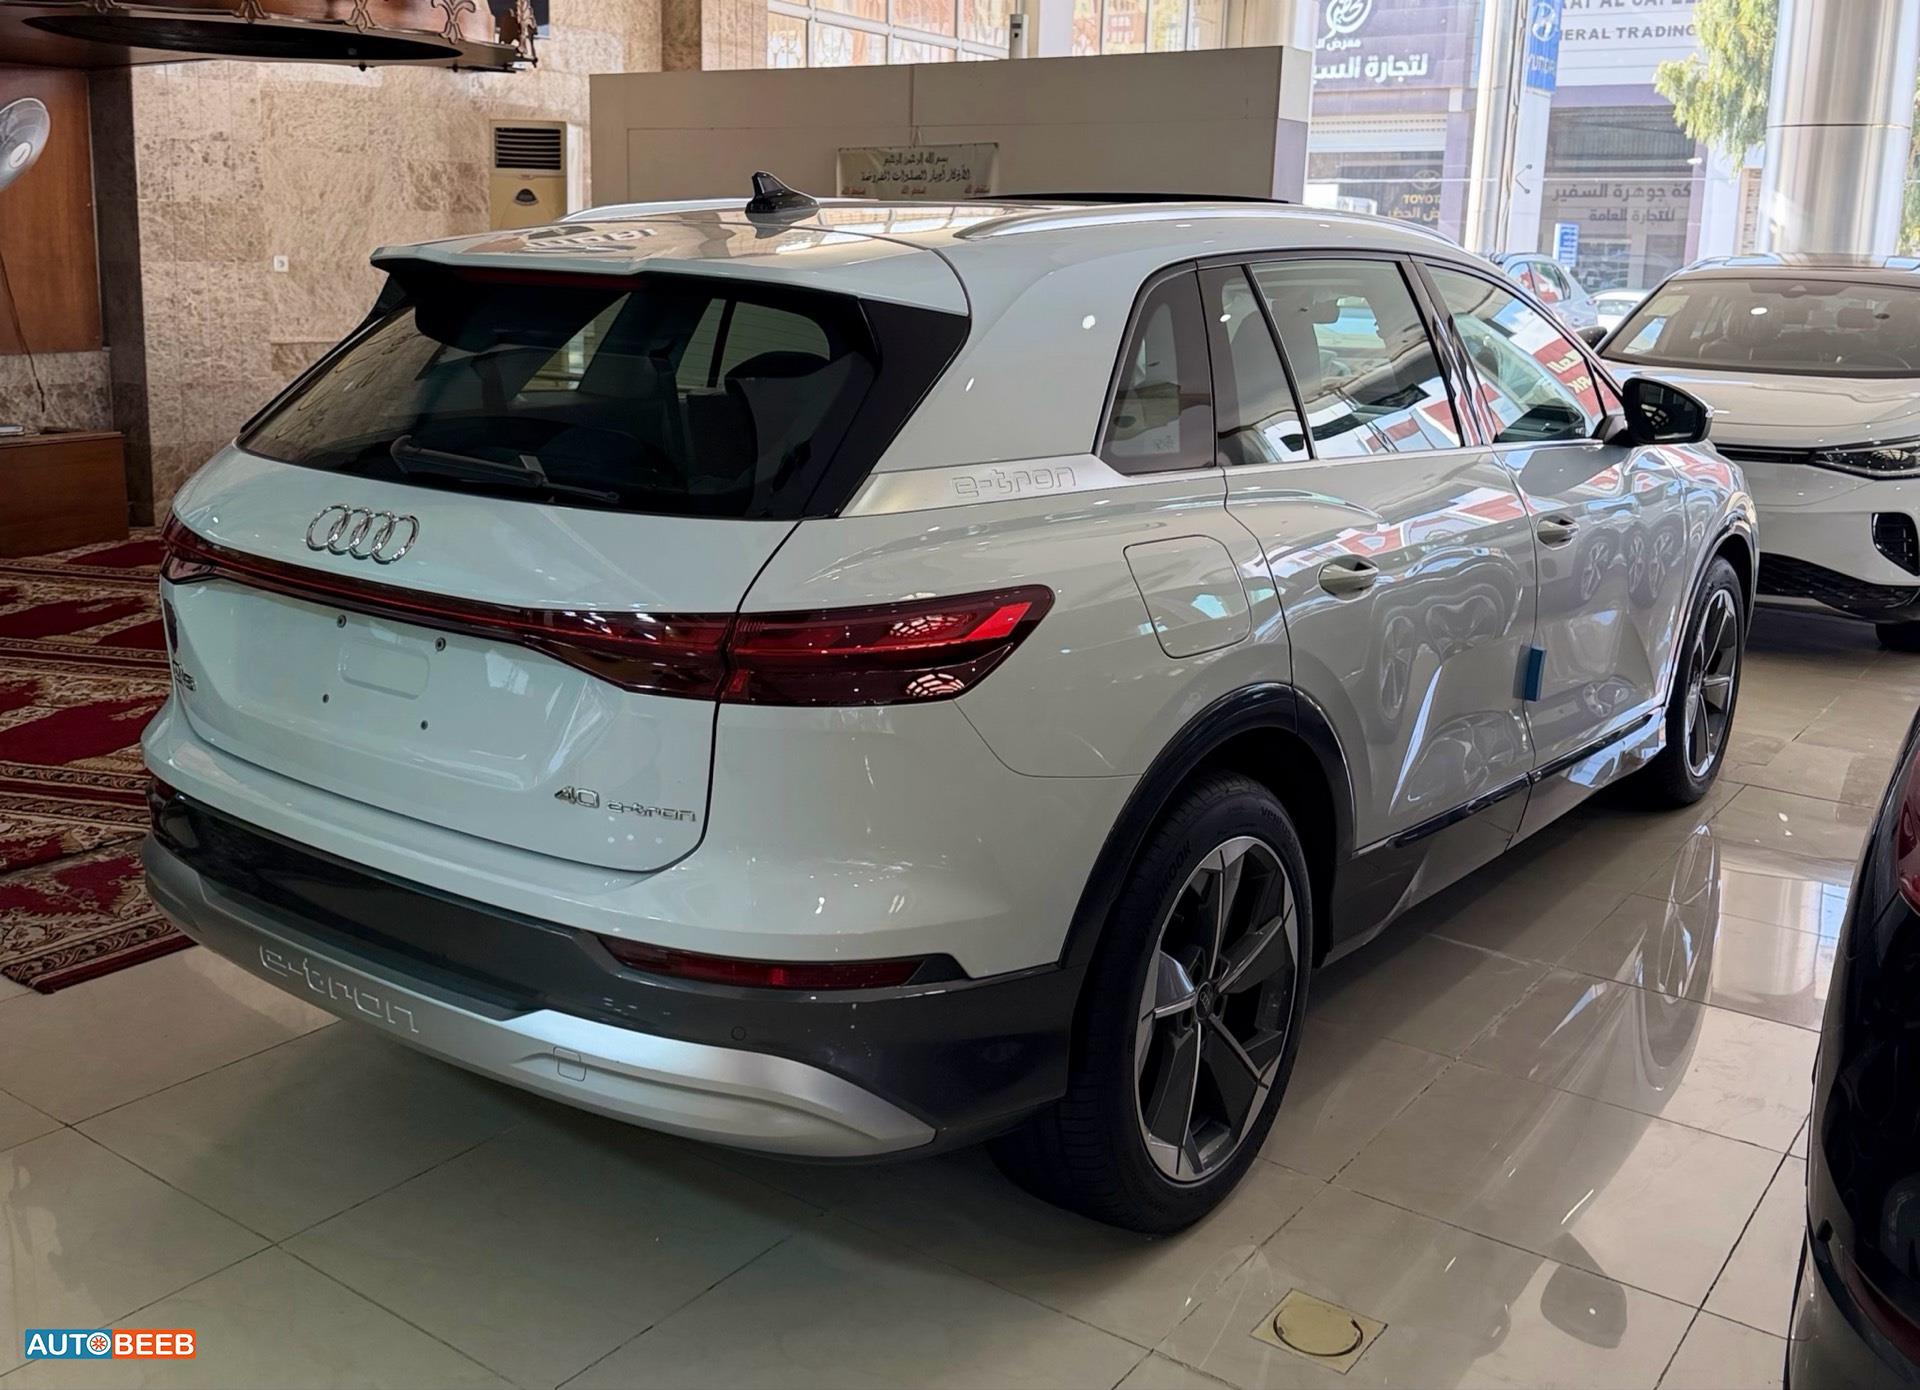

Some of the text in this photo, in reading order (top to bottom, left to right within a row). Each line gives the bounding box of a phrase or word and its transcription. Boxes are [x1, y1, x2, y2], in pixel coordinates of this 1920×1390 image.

[1365, 53, 1428, 84] لتجارة
[1551, 183, 1608, 202] السفير
[1613, 183, 1666, 202] جوهرة
[952, 466, 1077, 498] e-tron
[554, 785, 697, 822] 40 e-tron
[258, 944, 420, 1034] e-tron
